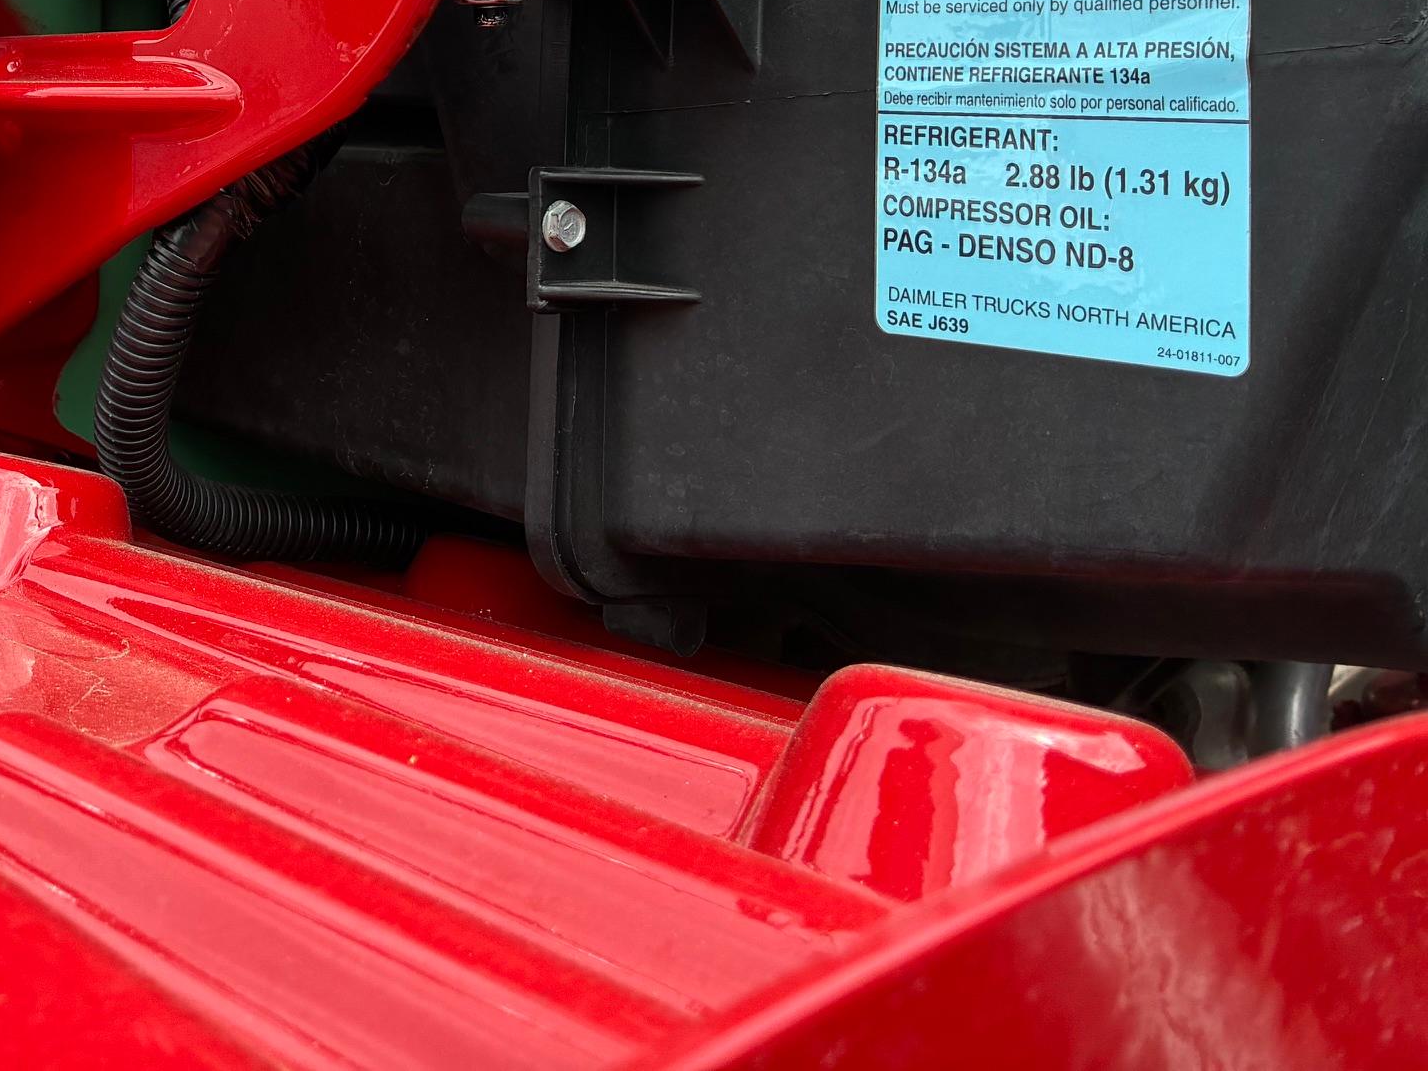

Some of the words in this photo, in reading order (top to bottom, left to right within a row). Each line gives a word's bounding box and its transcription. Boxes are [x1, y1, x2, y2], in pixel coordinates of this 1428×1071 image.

[886, 0, 920, 14] Must
[924, 0, 941, 14] be
[885, 38, 989, 59] PRECAUCIÓN
[995, 42, 1070, 59] SISTEMA
[1076, 43, 1088, 58] A
[1094, 42, 1137, 58] ALTA
[1145, 37, 1235, 61] PRESIÓN,
[884, 66, 964, 82] CONTIENE
[969, 66, 1104, 83] REFRIGERANTE
[1110, 68, 1150, 84] 134a
[884, 91, 913, 105] Debe
[917, 92, 952, 105] recibir
[956, 92, 1046, 109] mantenimiento
[1050, 95, 1077, 109] solo
[1081, 98, 1102, 112] por
[1106, 97, 1165, 113] personal
[1170, 96, 1239, 112] calificado.
[884, 124, 1059, 151] REFRIGERANT:
[884, 157, 966, 184] R-134a
[1006, 163, 1060, 189] 2.88
[1071, 166, 1095, 191] lb
[1104, 166, 1170, 199] (1.31
[1184, 171, 1230, 206] kg)
[883, 195, 1051, 226] COMPRESSOR
[1060, 206, 1110, 231] OIL:
[883, 228, 933, 254] PAG
[958, 234, 1055, 265] DENSO
[1066, 242, 1134, 271] ND-8
[887, 310, 923, 328] SAE
[928, 315, 969, 333] J639
[888, 286, 967, 309] DAIMLER
[973, 295, 1051, 318] TRUCKS
[1057, 305, 1129, 327] NORTH
[1136, 313, 1236, 339] AMERICA
[1157, 346, 1240, 367] 24-01811-007
